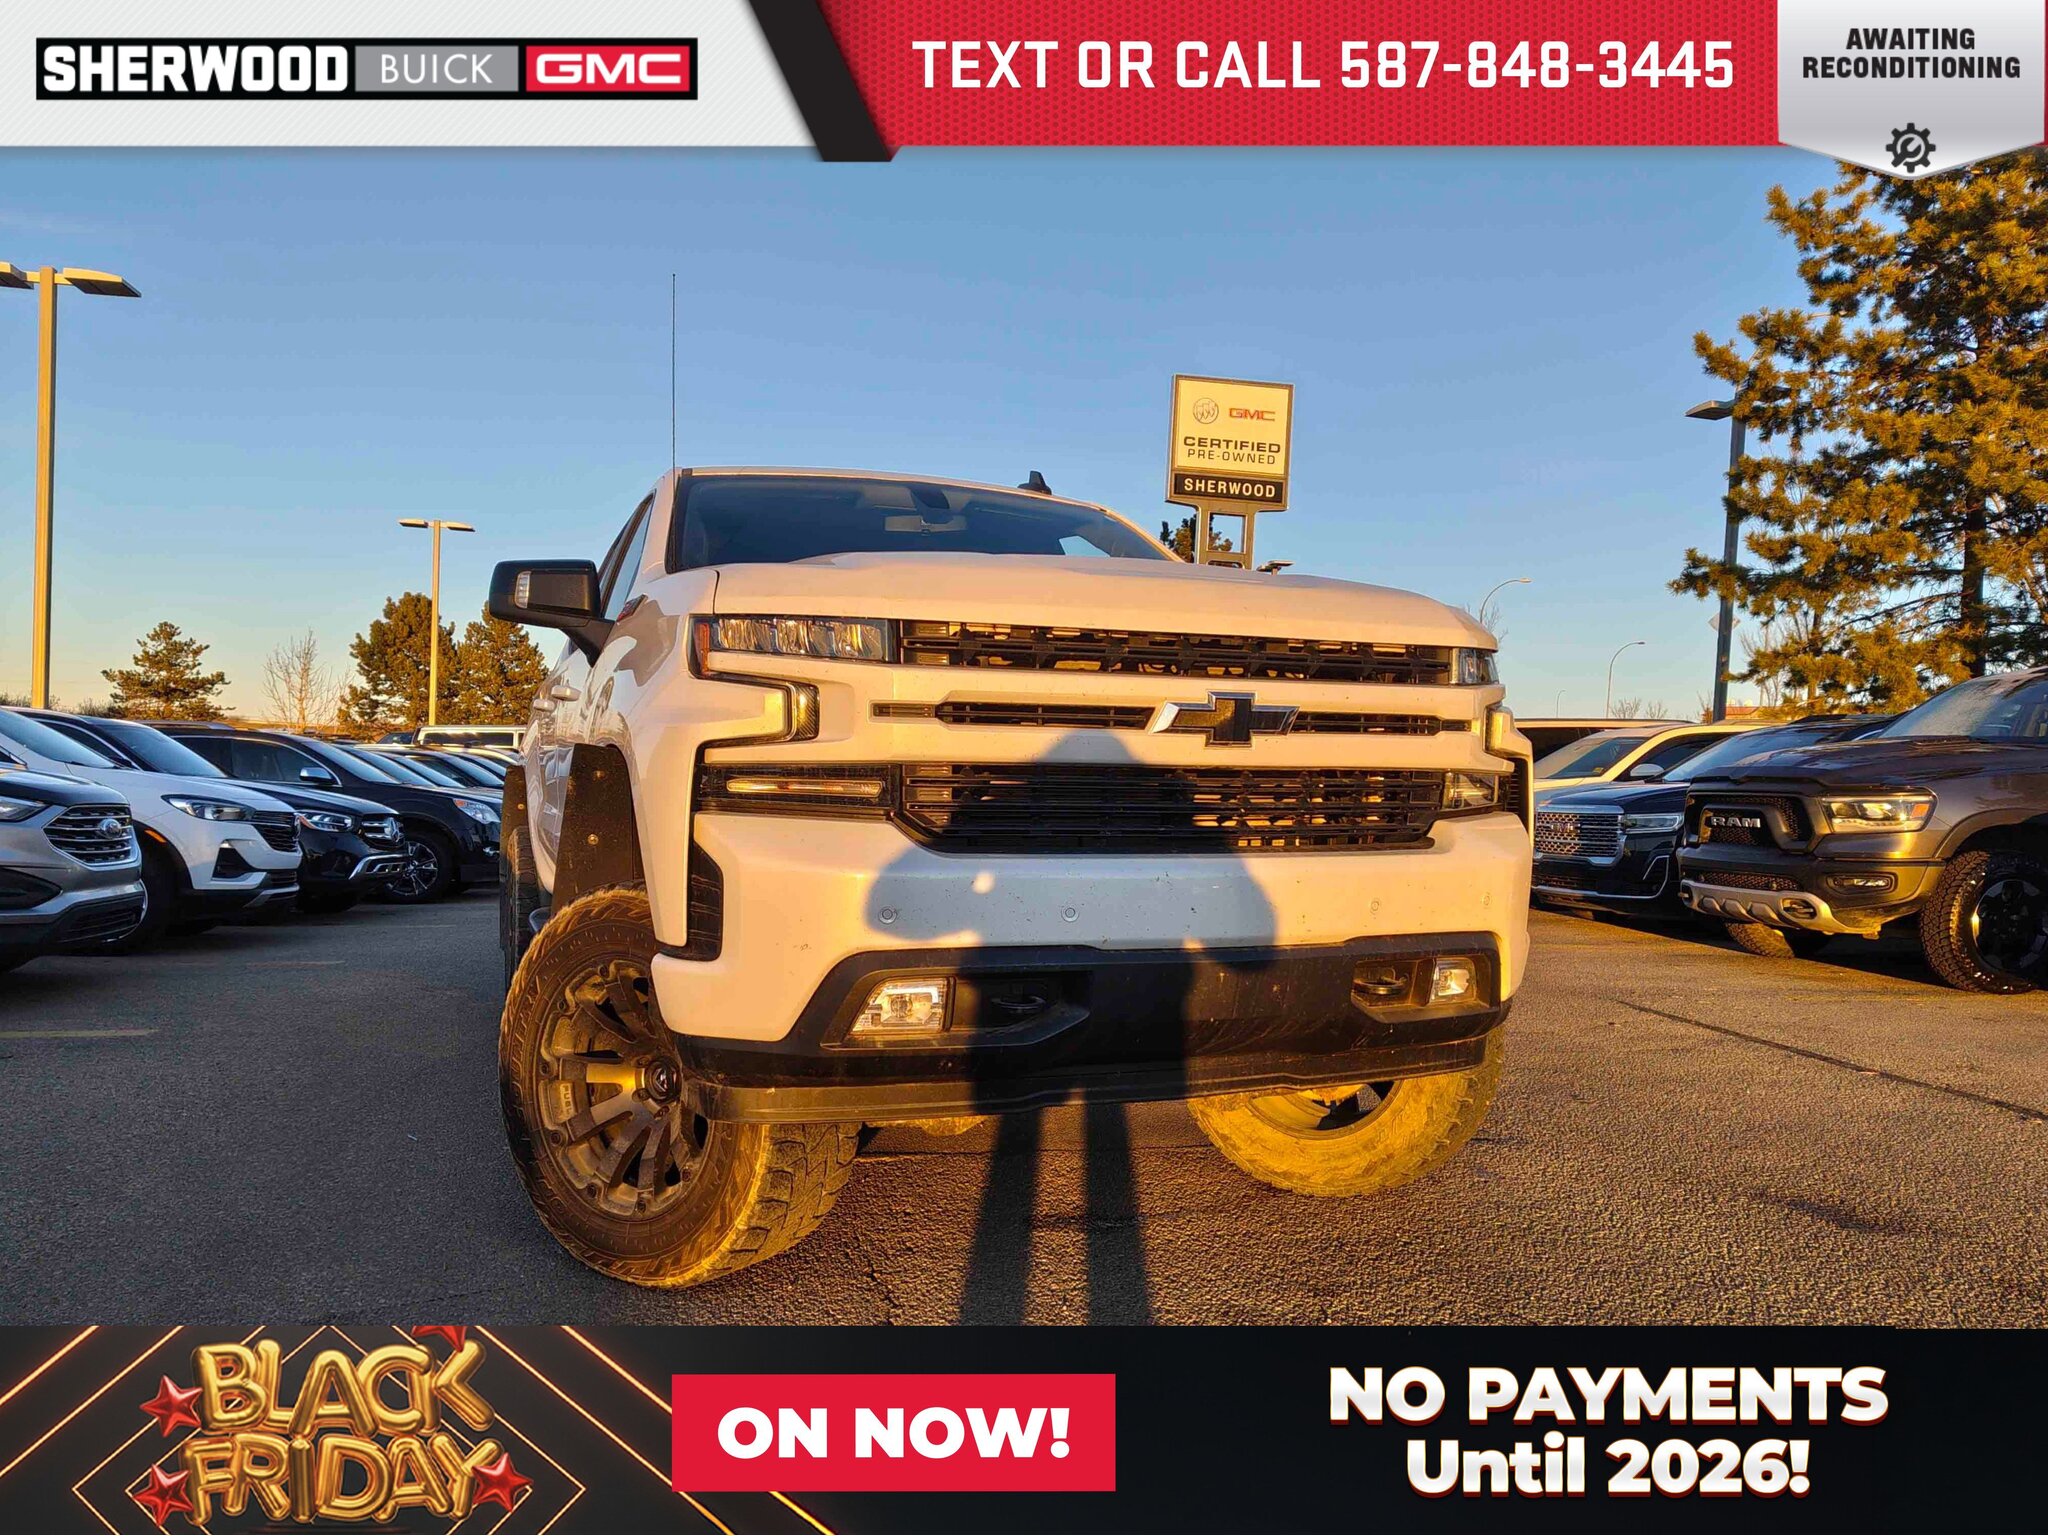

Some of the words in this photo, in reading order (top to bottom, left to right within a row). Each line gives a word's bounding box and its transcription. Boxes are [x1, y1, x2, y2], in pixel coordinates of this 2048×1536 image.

[1229, 407, 1275, 422] GMC
[1183, 436, 1281, 453] CERTIFIED
[1187, 448, 1276, 465] PRE-OWNED
[1184, 478, 1276, 498] SHERWOOD
[1710, 816, 1761, 828] RAM
